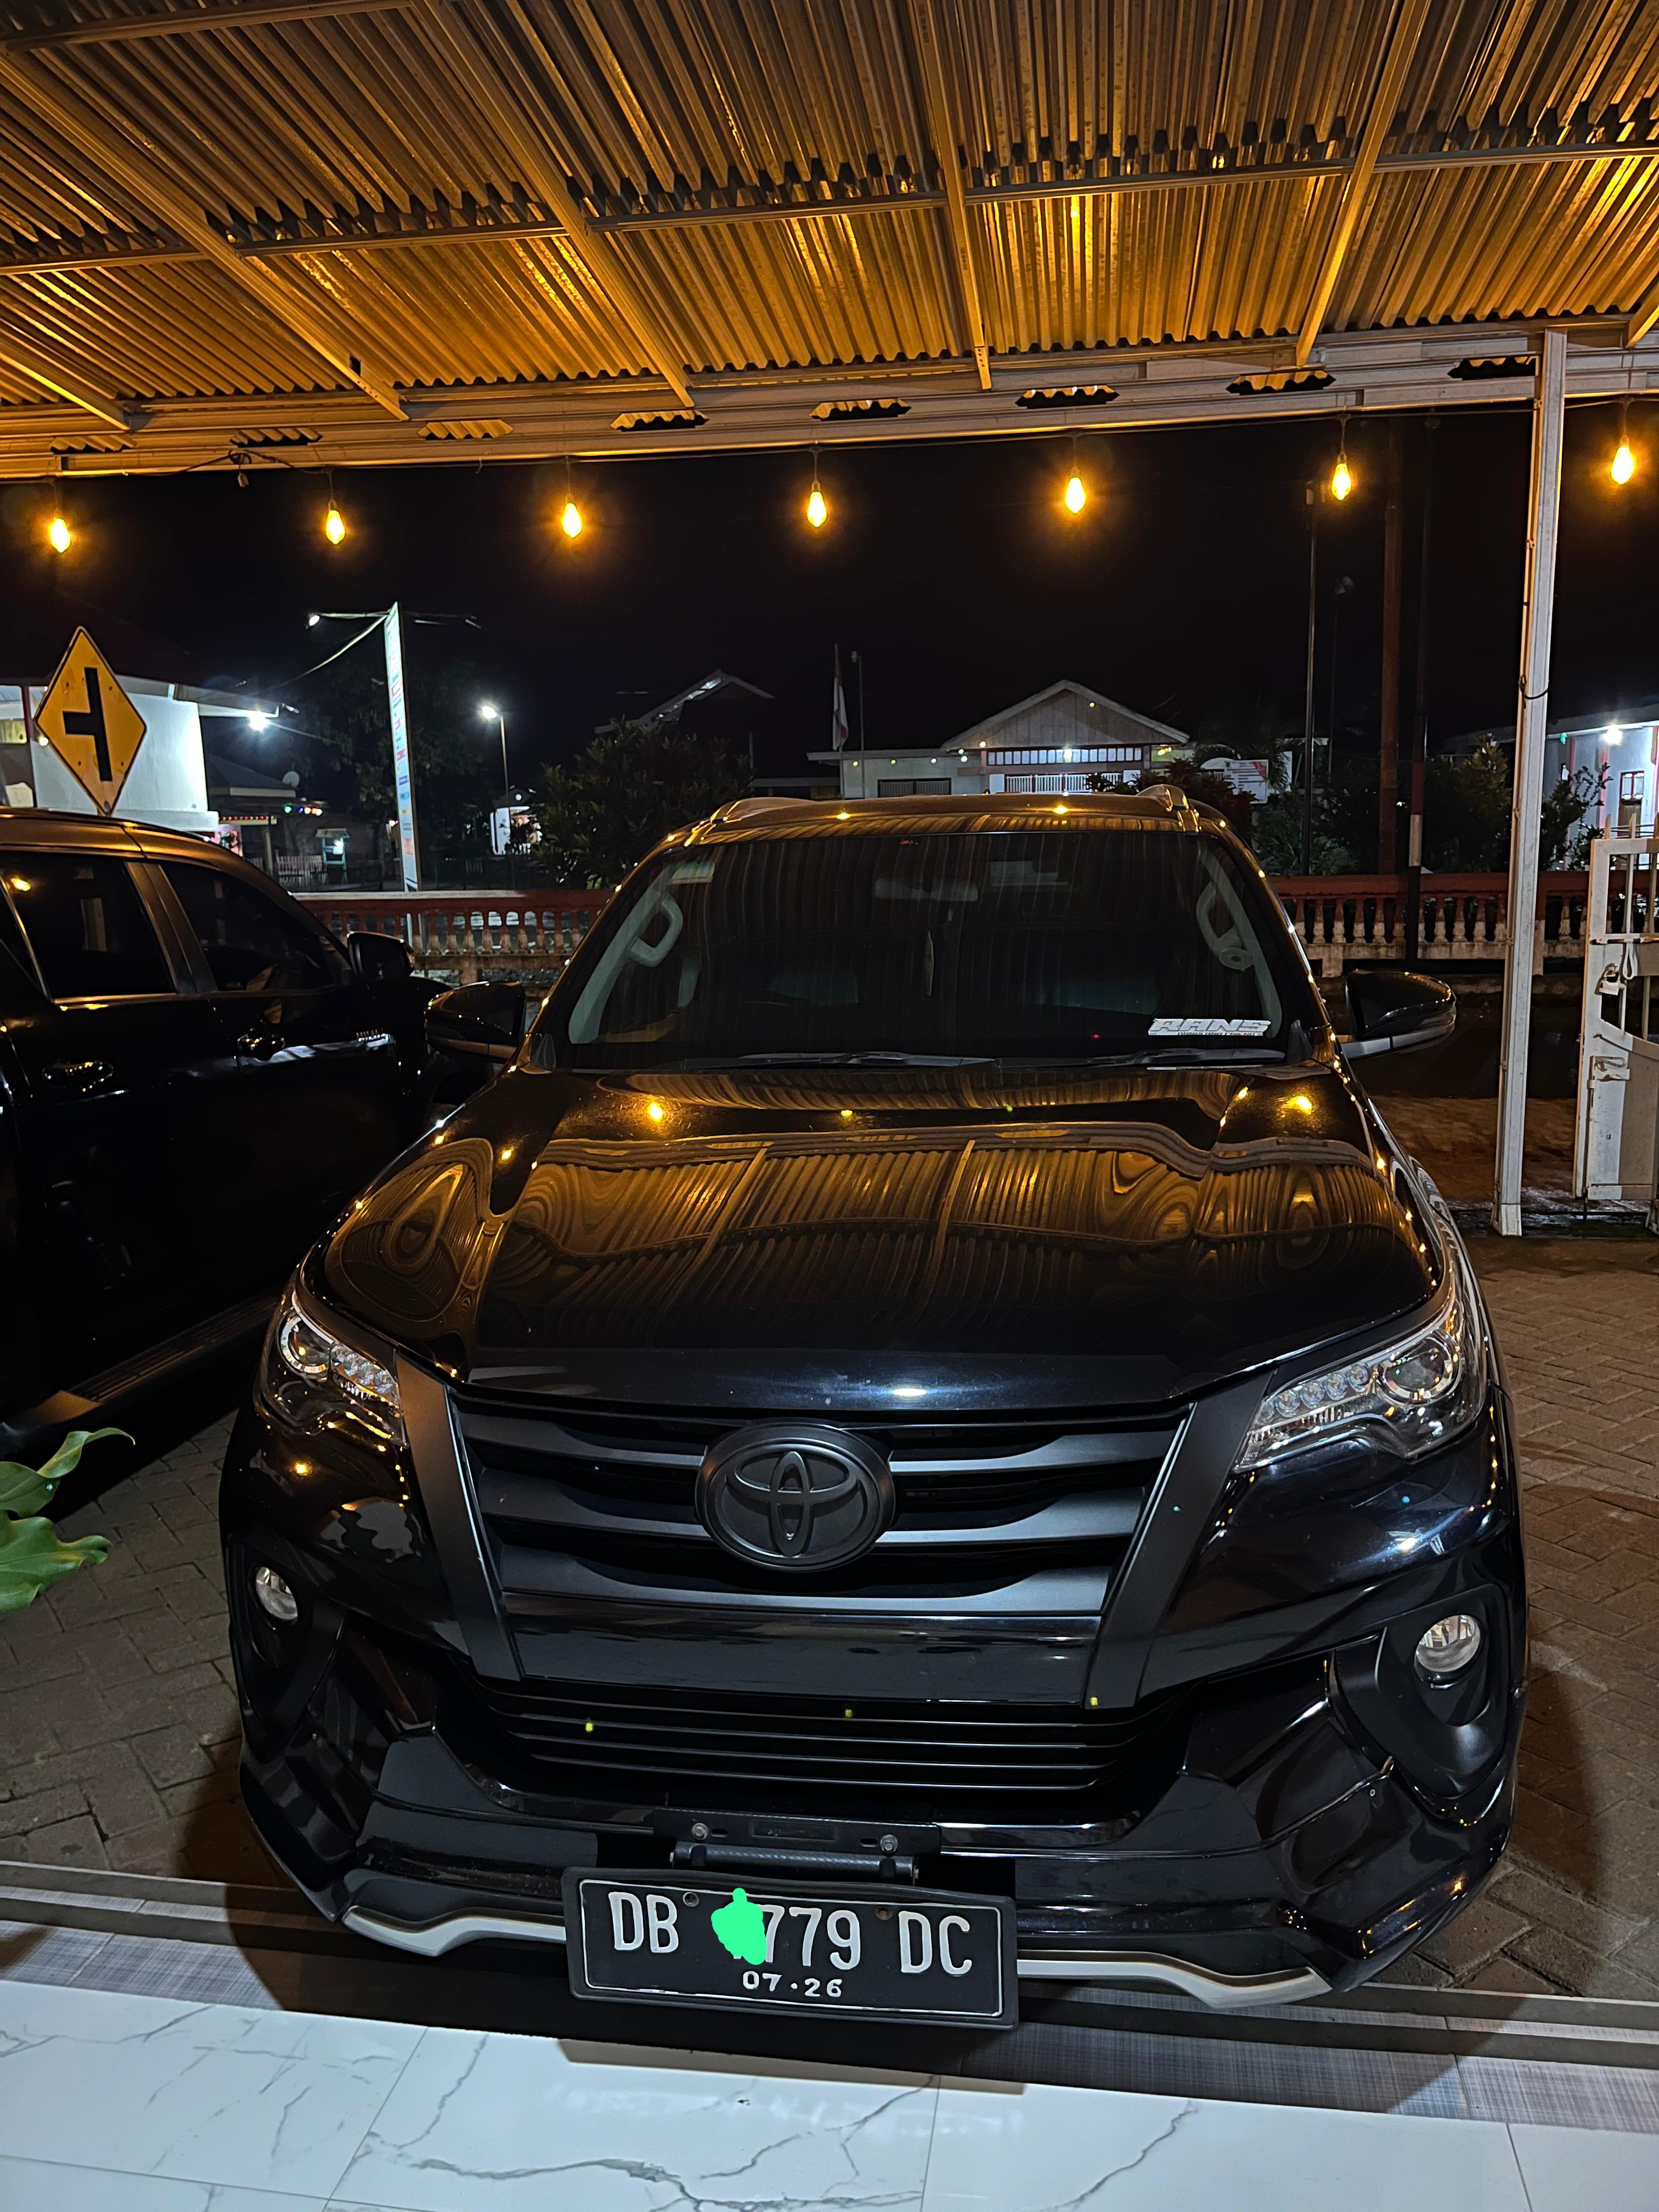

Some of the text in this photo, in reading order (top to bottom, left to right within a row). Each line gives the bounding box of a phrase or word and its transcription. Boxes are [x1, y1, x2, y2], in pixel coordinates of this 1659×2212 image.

[1148, 1018, 1272, 1032] RANS
[608, 1891, 973, 1975] DB 779 DC
